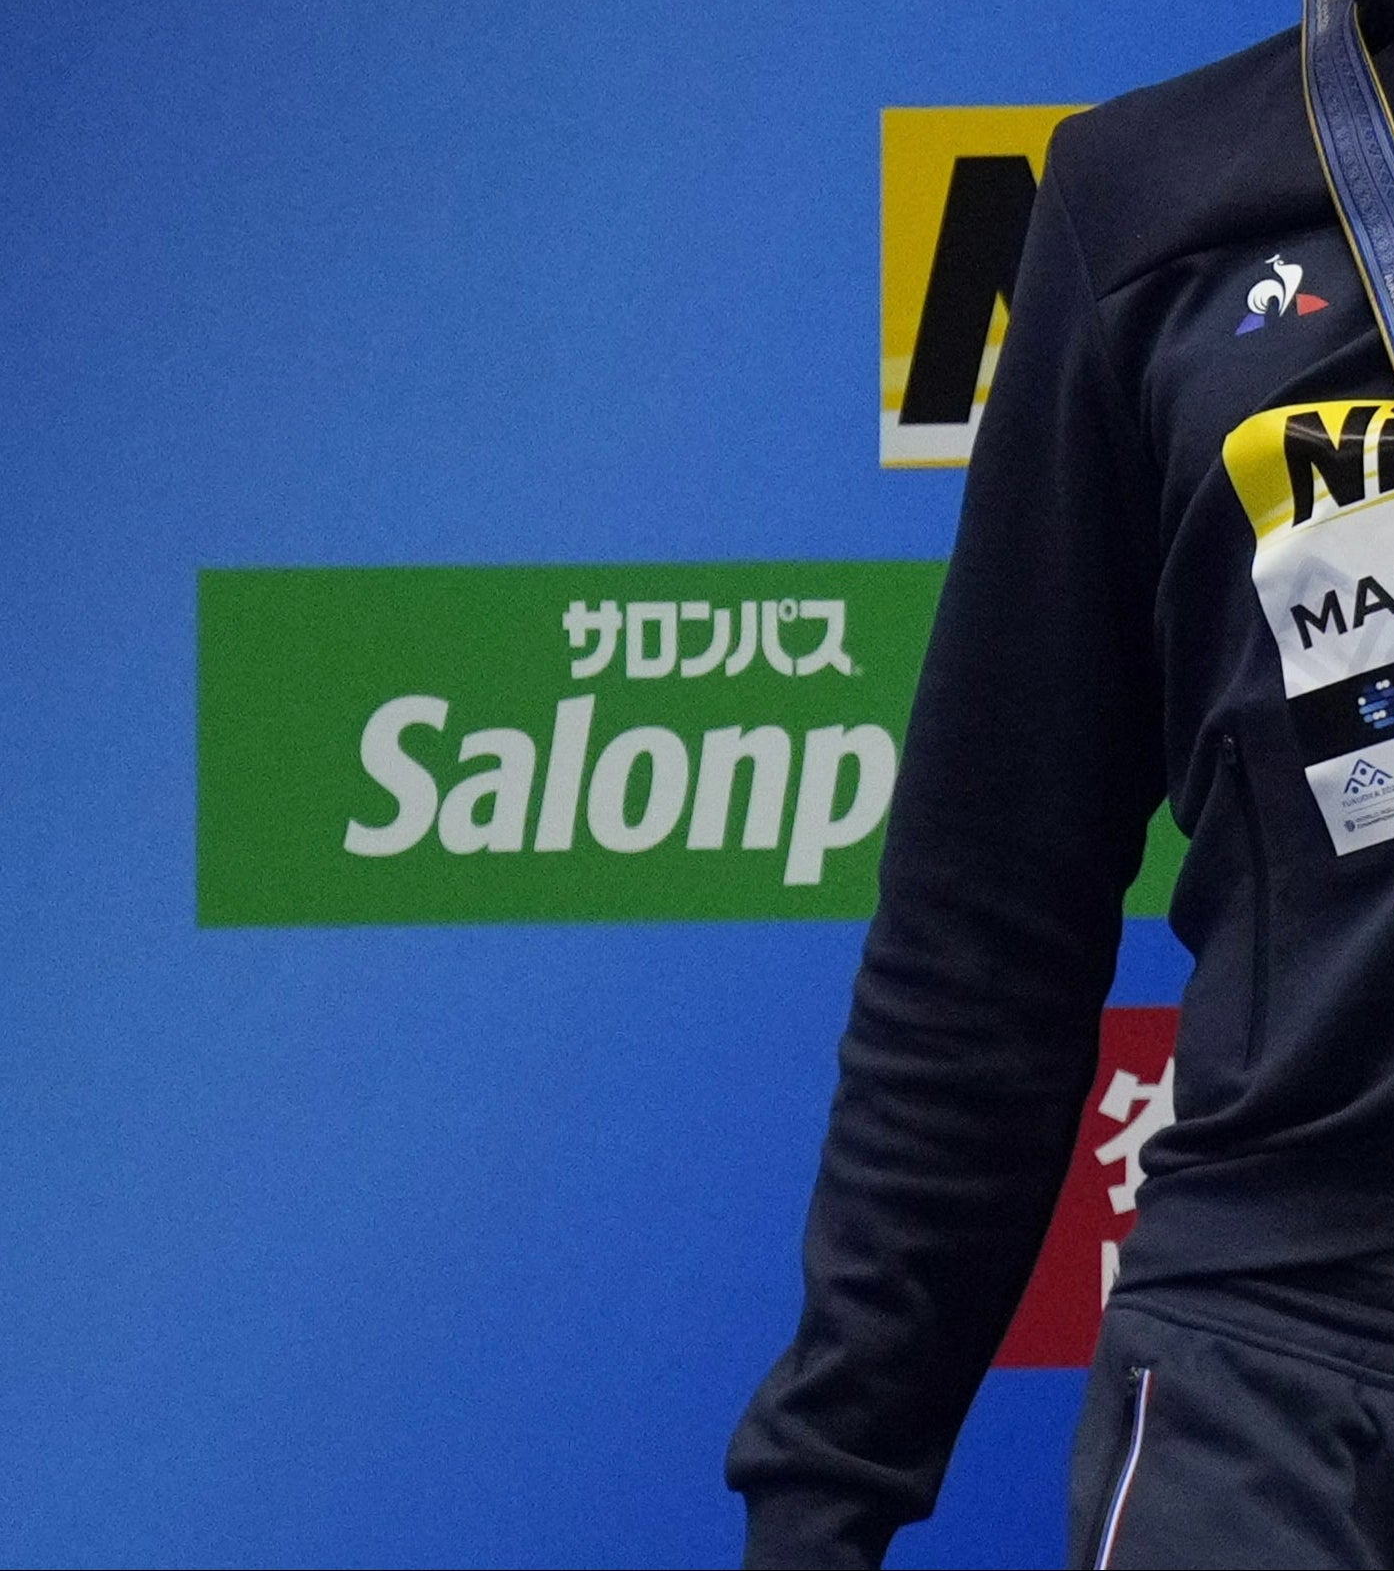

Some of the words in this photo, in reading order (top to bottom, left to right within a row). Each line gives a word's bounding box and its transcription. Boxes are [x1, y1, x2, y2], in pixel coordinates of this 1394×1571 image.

[562, 597, 852, 679] サロンパス
